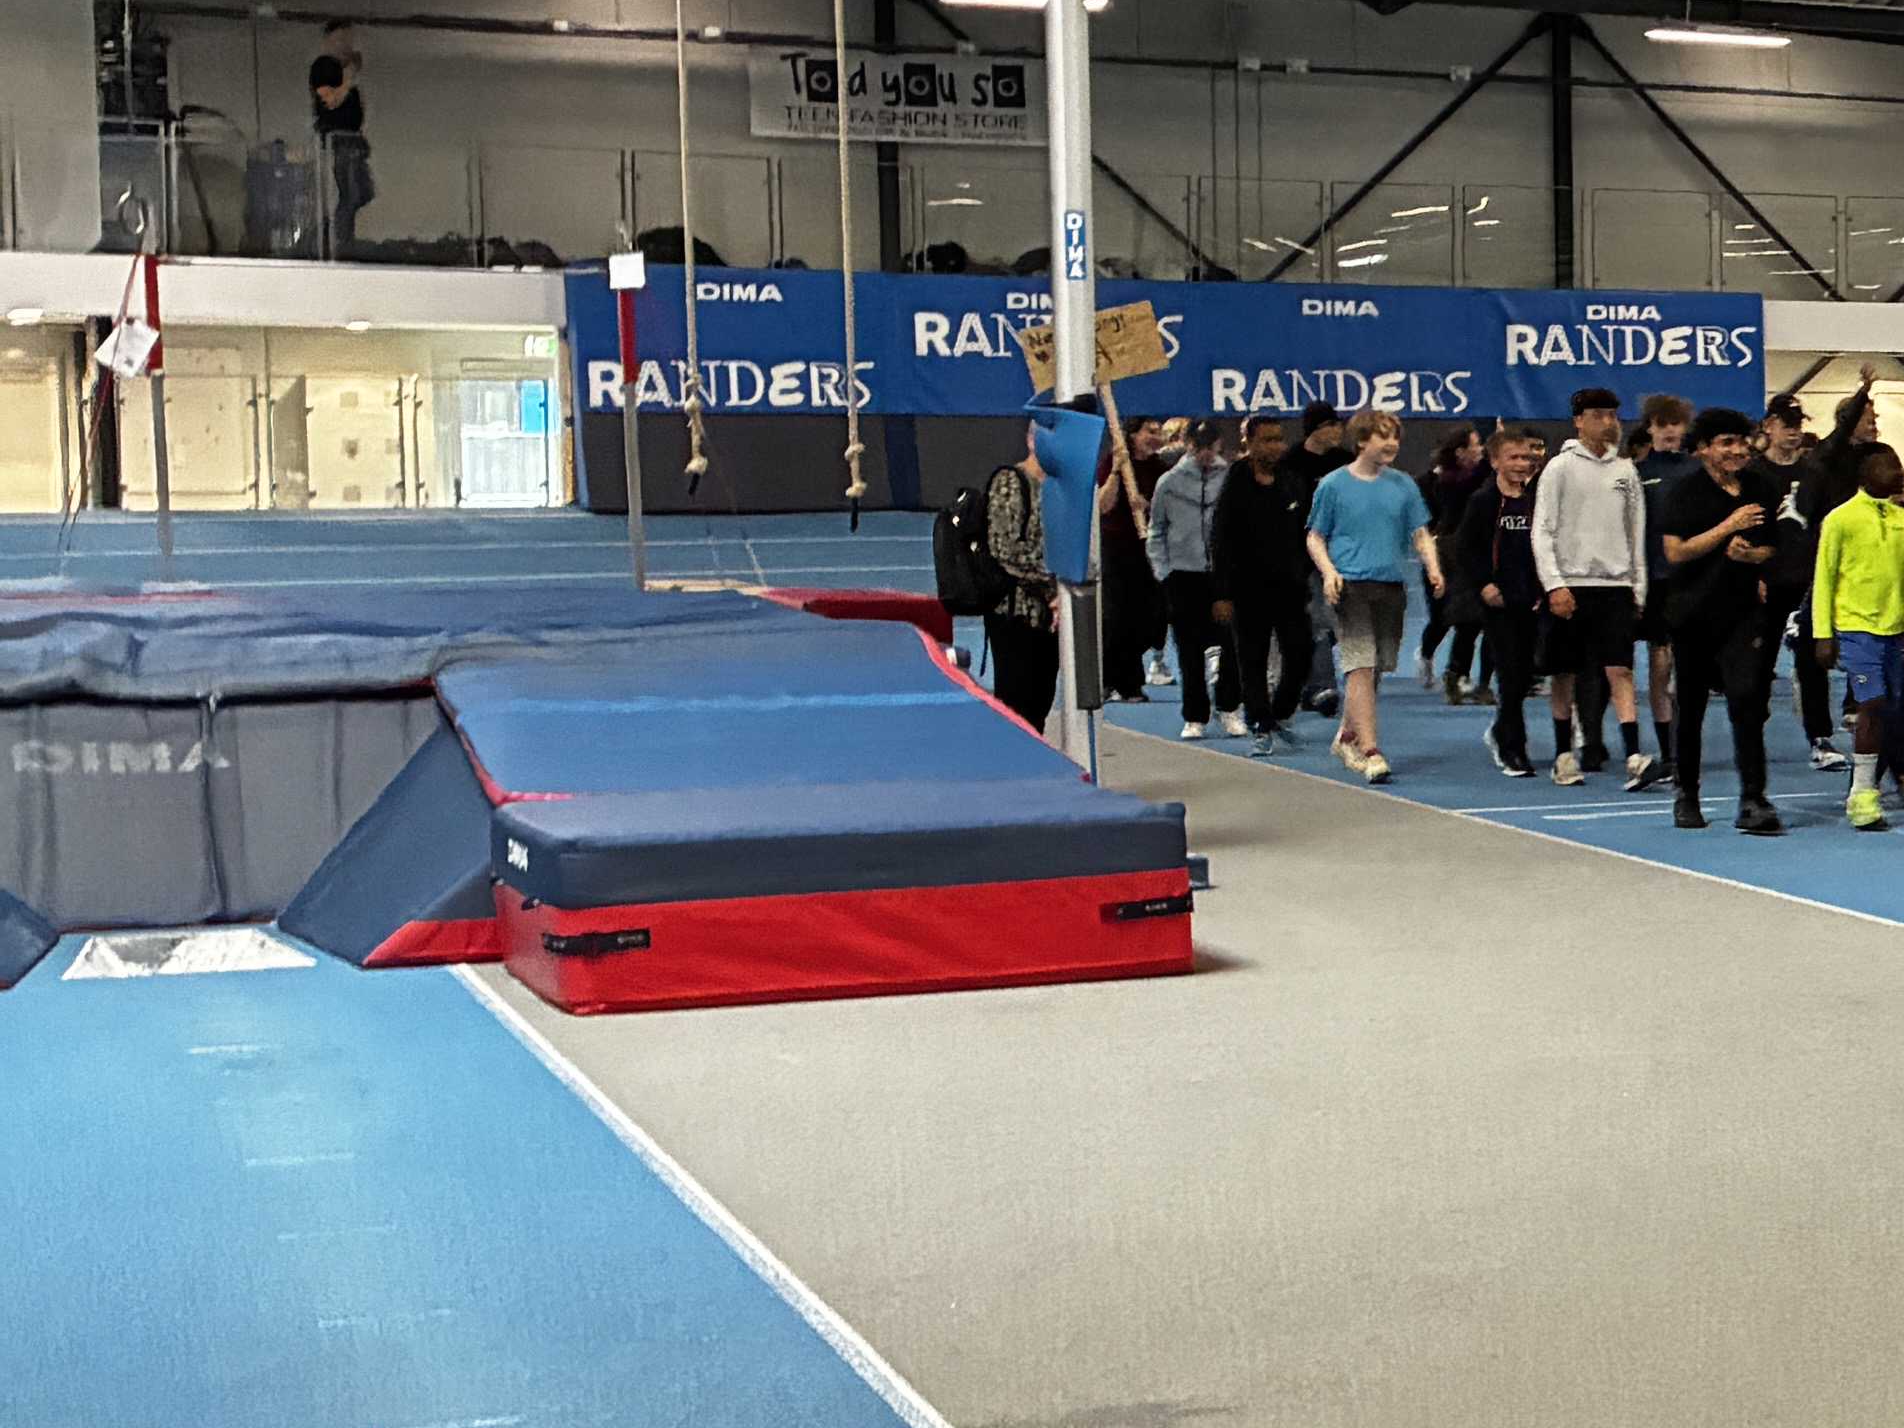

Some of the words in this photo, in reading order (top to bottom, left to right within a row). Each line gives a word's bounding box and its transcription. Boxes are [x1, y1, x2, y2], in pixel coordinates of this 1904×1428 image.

[881, 63, 957, 107] you
[971, 64, 1026, 108] so
[850, 108, 947, 128] FASHION
[1065, 212, 1085, 278] DIMA
[696, 283, 783, 302] DIMA
[1301, 299, 1379, 317] DIMA
[1586, 304, 1662, 321] DIMA
[1506, 323, 1757, 368] RANDERS
[1212, 368, 1472, 413] RANDERS
[11, 740, 231, 773] DIMA
